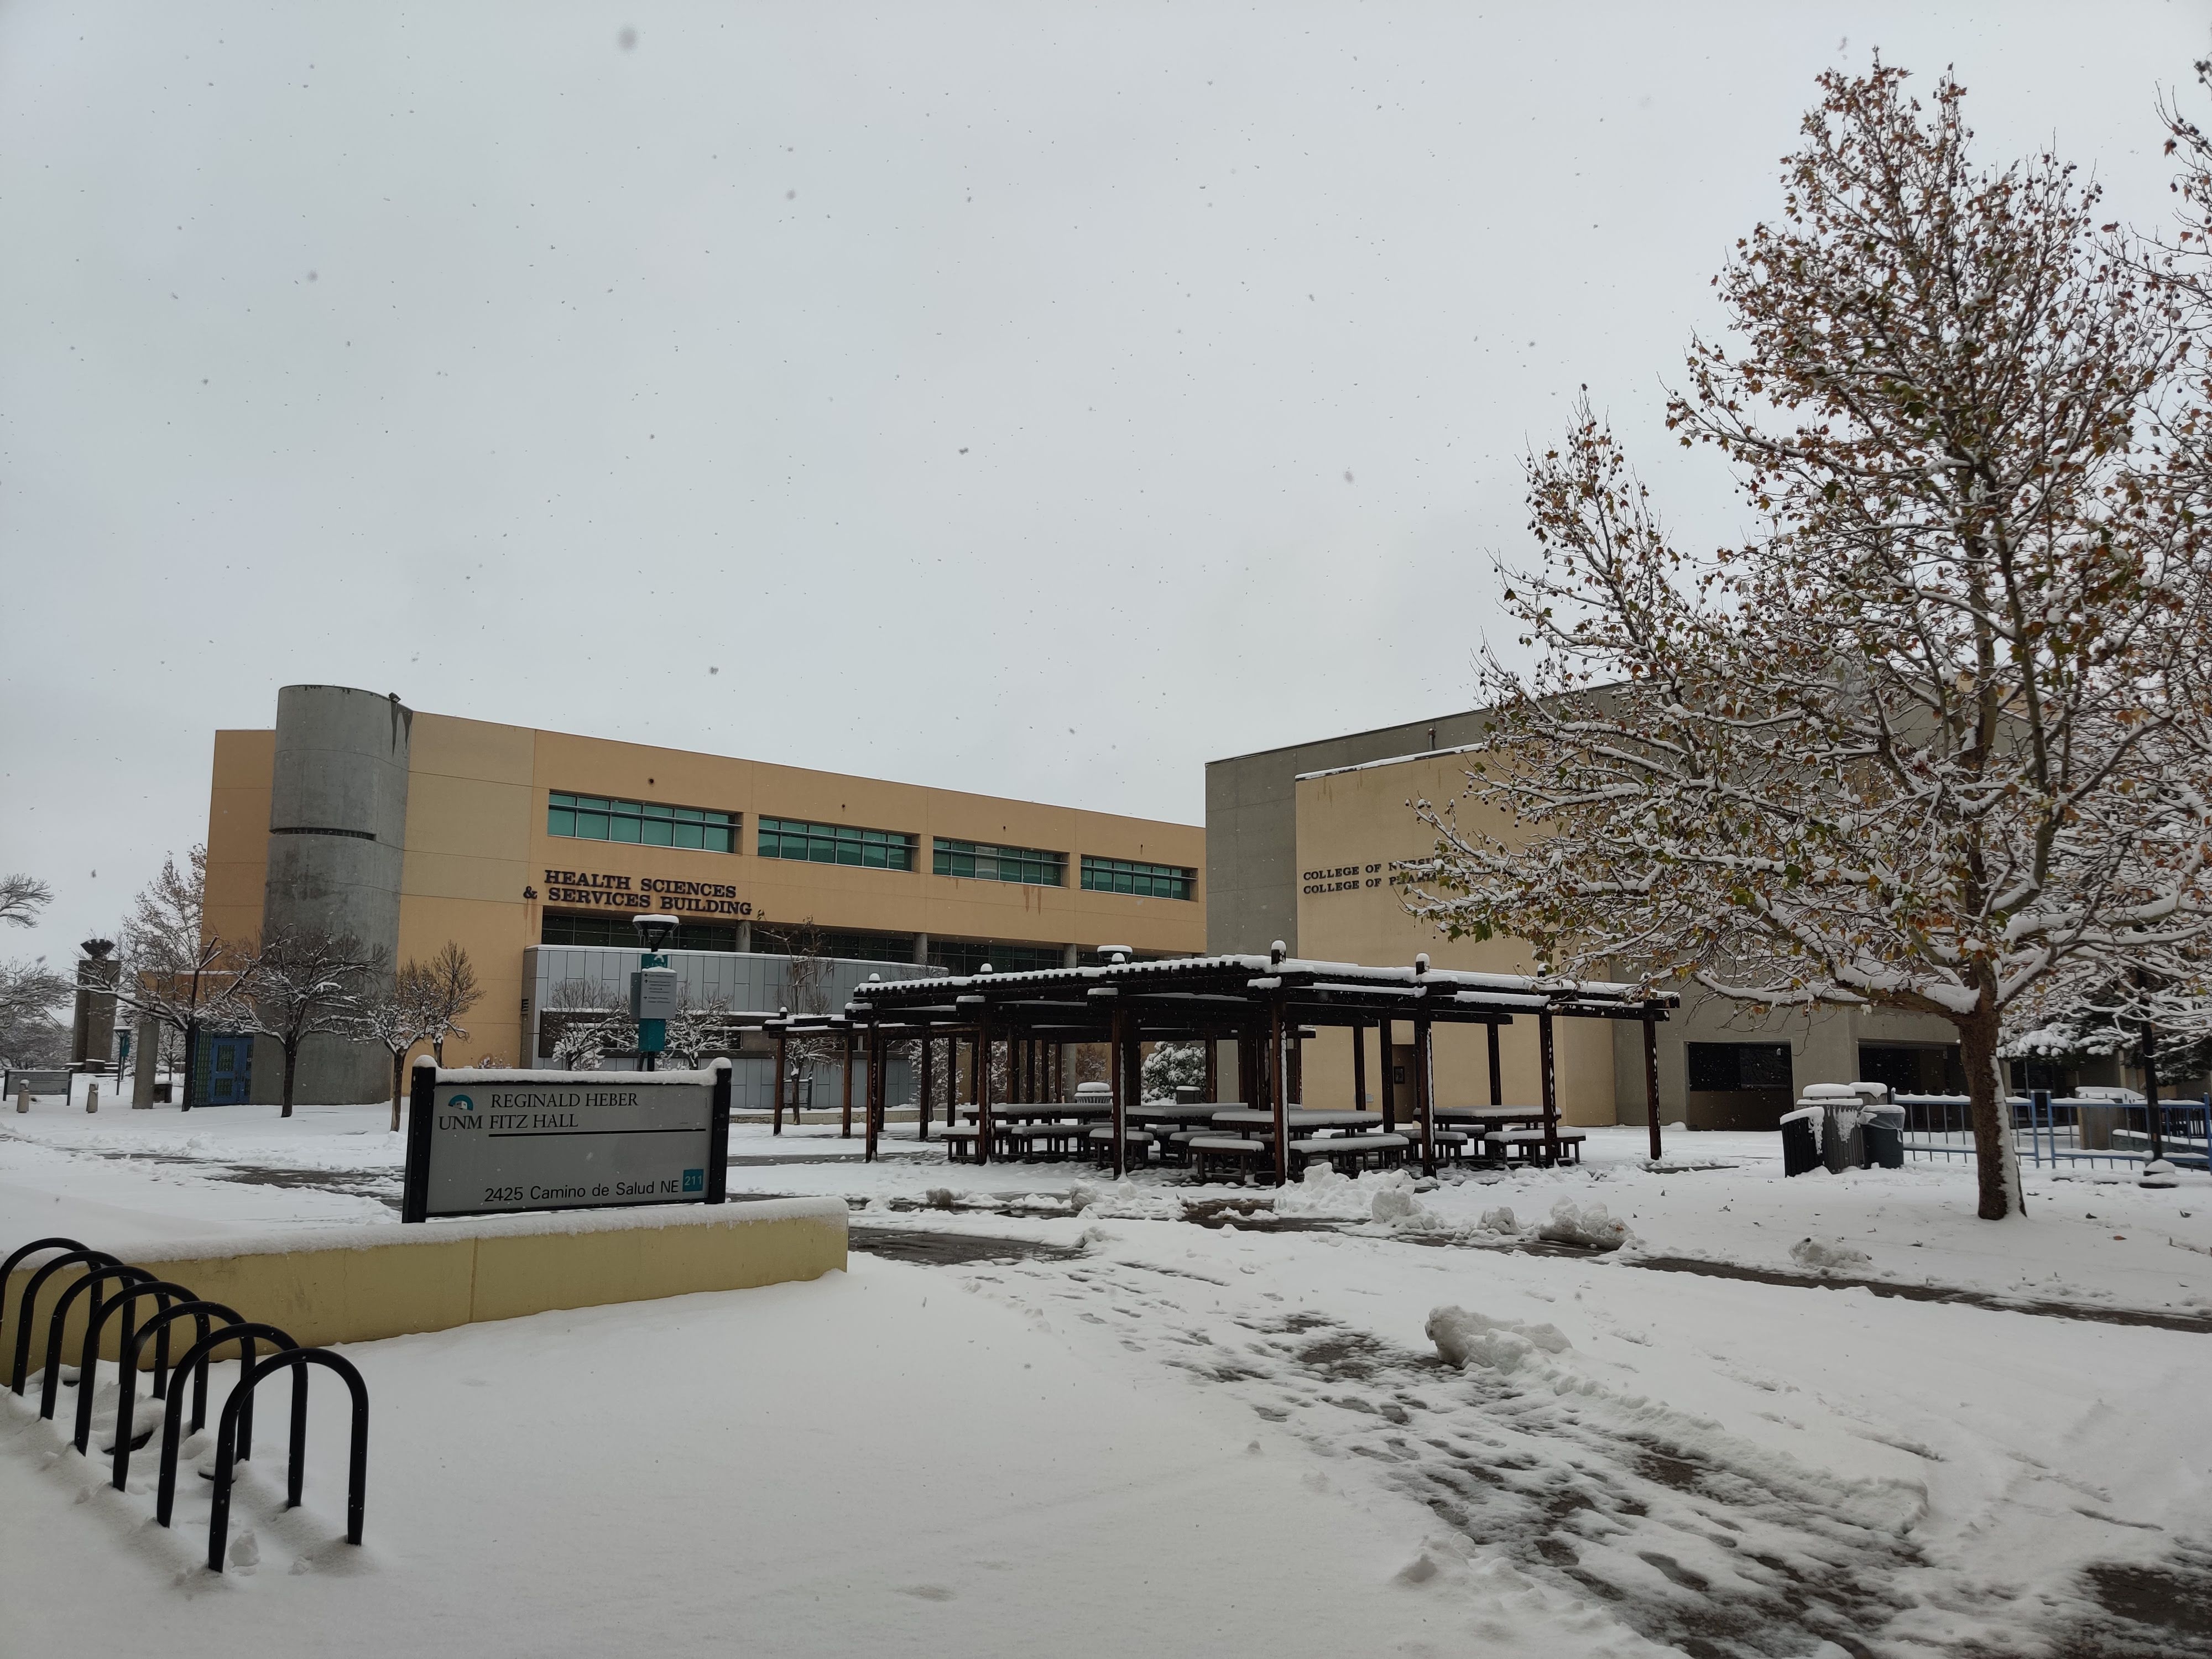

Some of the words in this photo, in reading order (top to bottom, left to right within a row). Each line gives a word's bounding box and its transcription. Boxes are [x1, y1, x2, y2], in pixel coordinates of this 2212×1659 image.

[1303, 866, 1359, 880] COLLEGE
[1365, 864, 1382, 873] OF
[544, 870, 632, 890] HEALTH
[640, 878, 737, 899] SCIENCES
[1303, 880, 1360, 894] COLLEGE
[1365, 878, 1382, 888] OF
[523, 886, 538, 900] &
[549, 887, 651, 908] SERVICES
[660, 896, 753, 915] BUILDING
[490, 1093, 581, 1108] REGINALD
[586, 1093, 639, 1107] HEBER
[438, 1115, 484, 1130] UNM
[489, 1114, 528, 1130] FITZ
[533, 1113, 579, 1129] HALL
[684, 1175, 703, 1187] 211
[484, 1186, 524, 1202] 2425
[530, 1184, 586, 1201] Camino
[592, 1183, 609, 1197] de
[615, 1181, 655, 1196] Salud
[660, 1180, 680, 1193] NE
